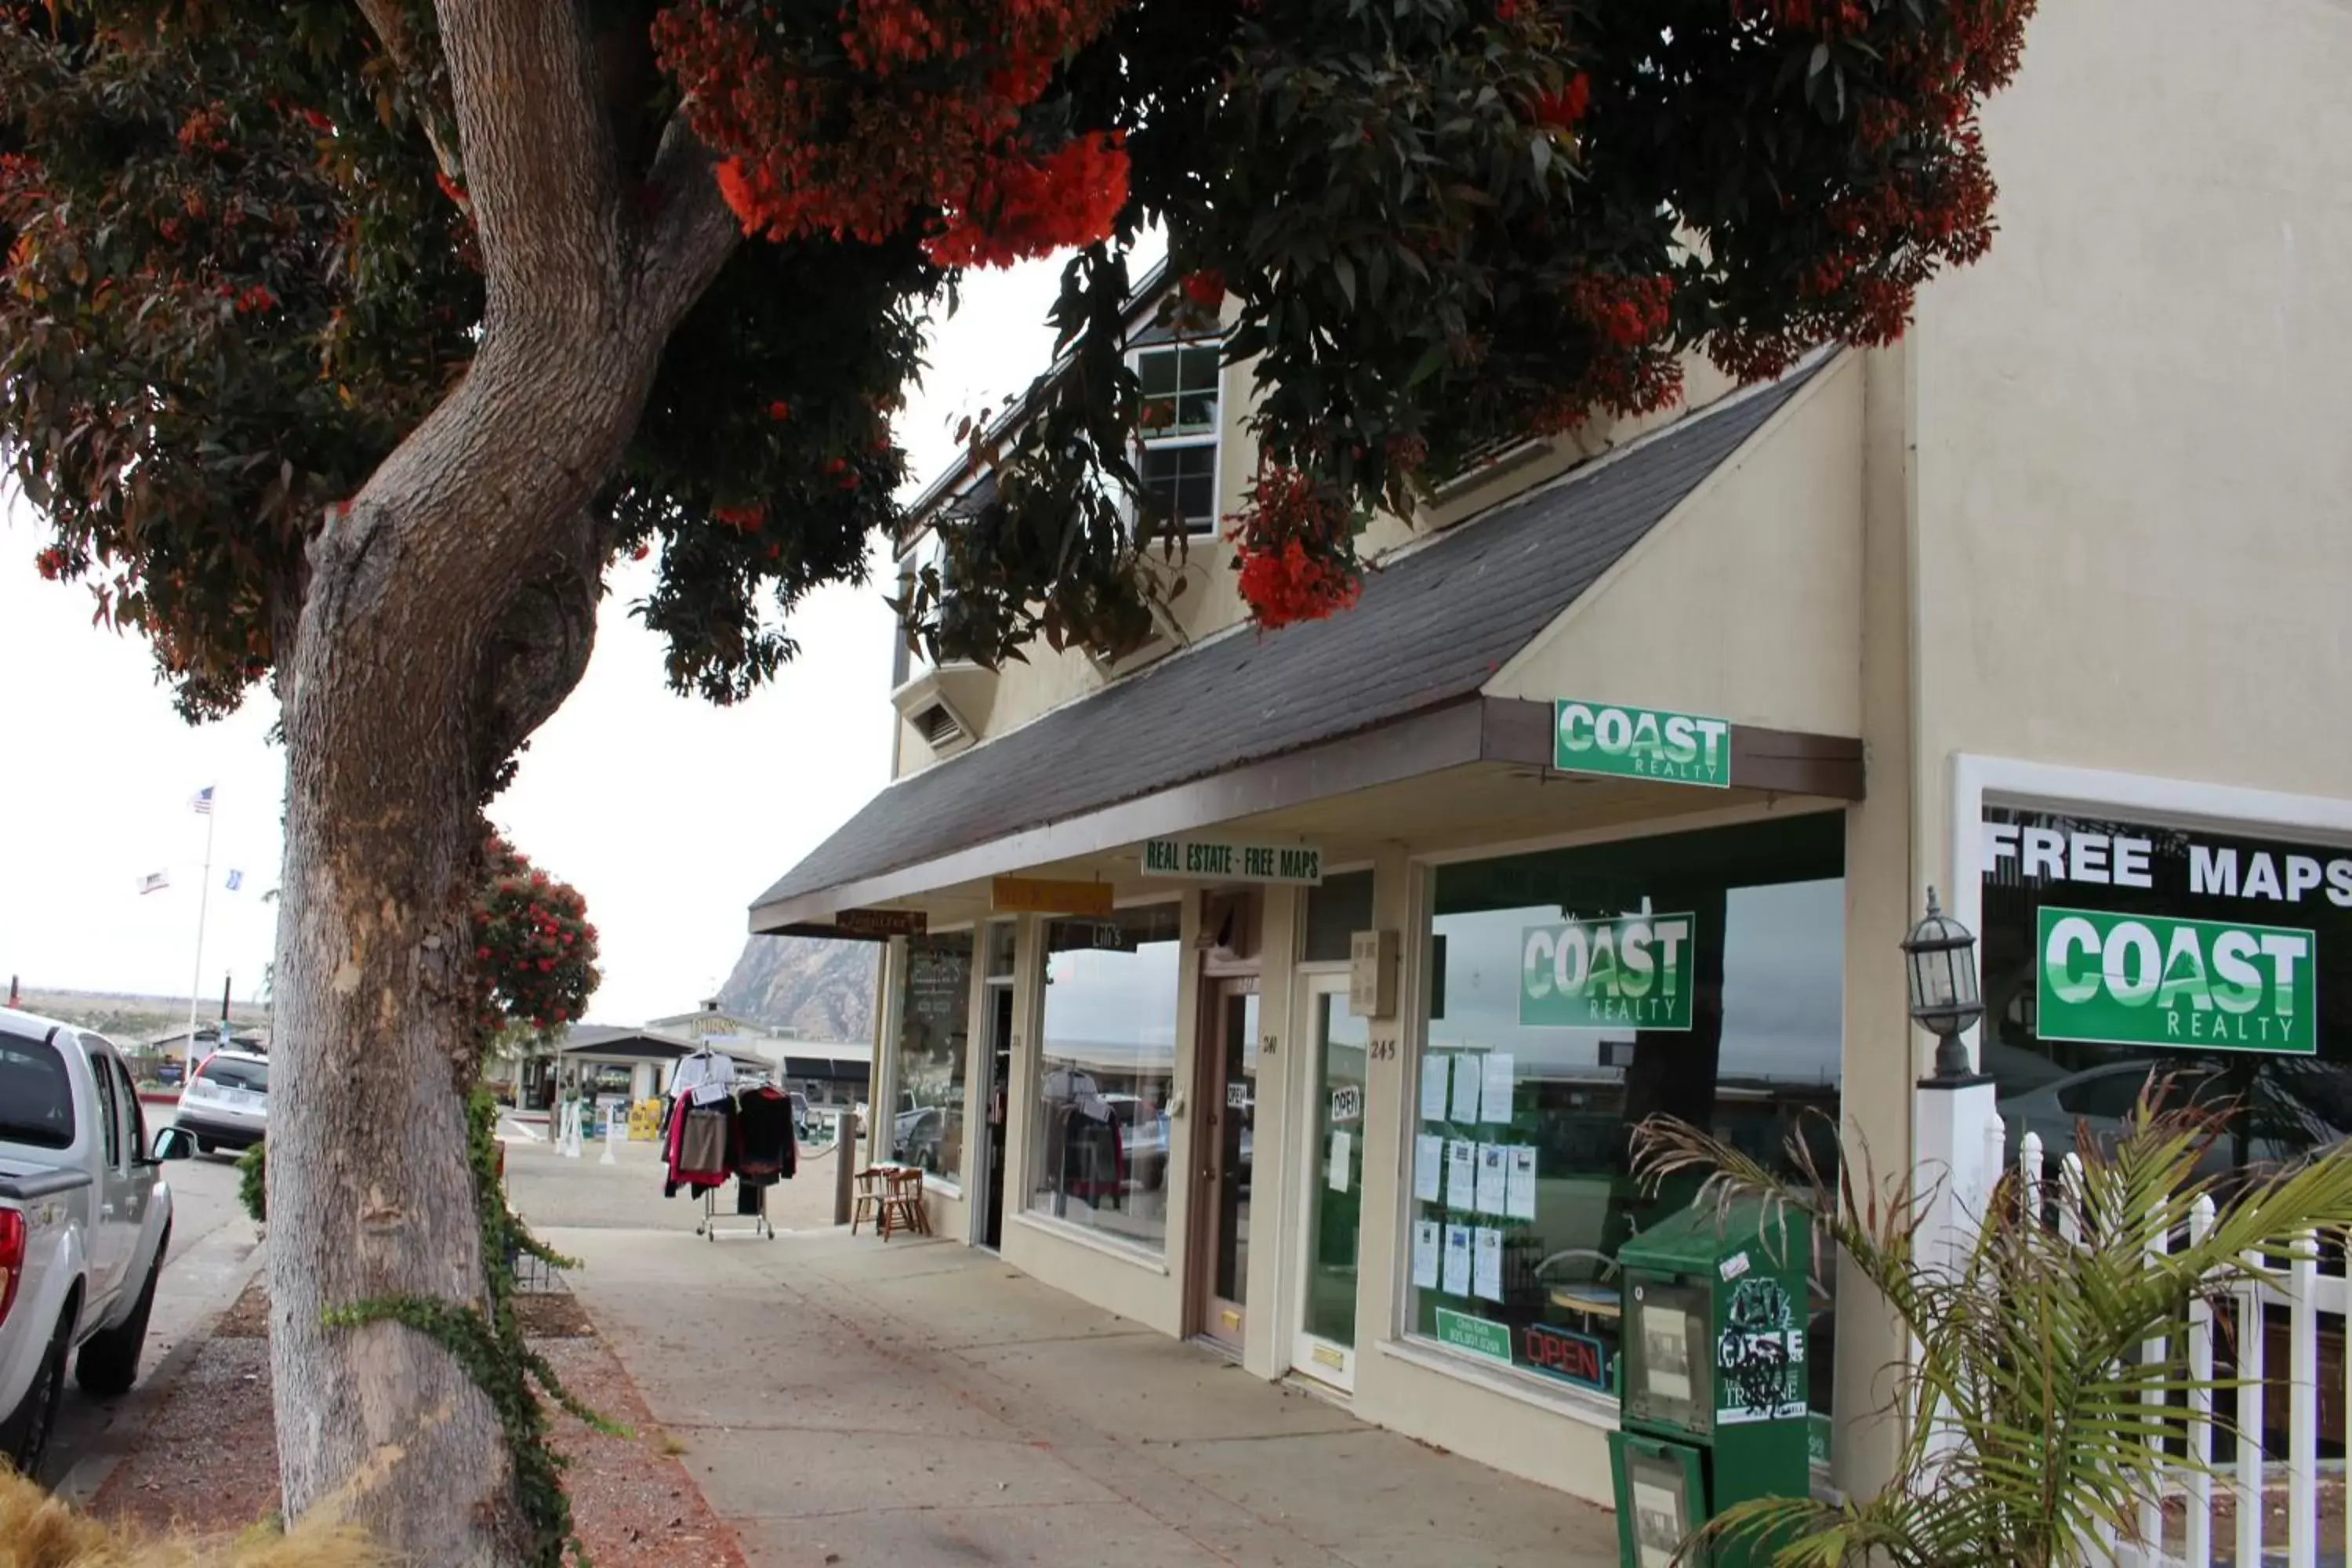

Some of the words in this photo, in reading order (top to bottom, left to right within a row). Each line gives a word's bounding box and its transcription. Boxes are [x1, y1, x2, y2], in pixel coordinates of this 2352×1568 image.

[1559, 703, 1726, 766] COAST
[1635, 758, 1717, 782] REALTY
[1147, 840, 1180, 871] REAL
[1187, 843, 1232, 875] ESTATE
[1245, 847, 1274, 877] FREE
[1279, 850, 1319, 879] MAPS
[1982, 822, 2152, 888] FREE
[2190, 845, 2352, 907] MAPS
[1523, 920, 1688, 1000] COAST
[2046, 916, 2307, 1017] COAST
[1590, 998, 1676, 1021] REALTY
[2168, 1011, 2293, 1042] REALTY
[1371, 1039, 1396, 1061] 245
[1334, 1088, 1358, 1117] OPEN
[1526, 1331, 1598, 1381] OPEN
